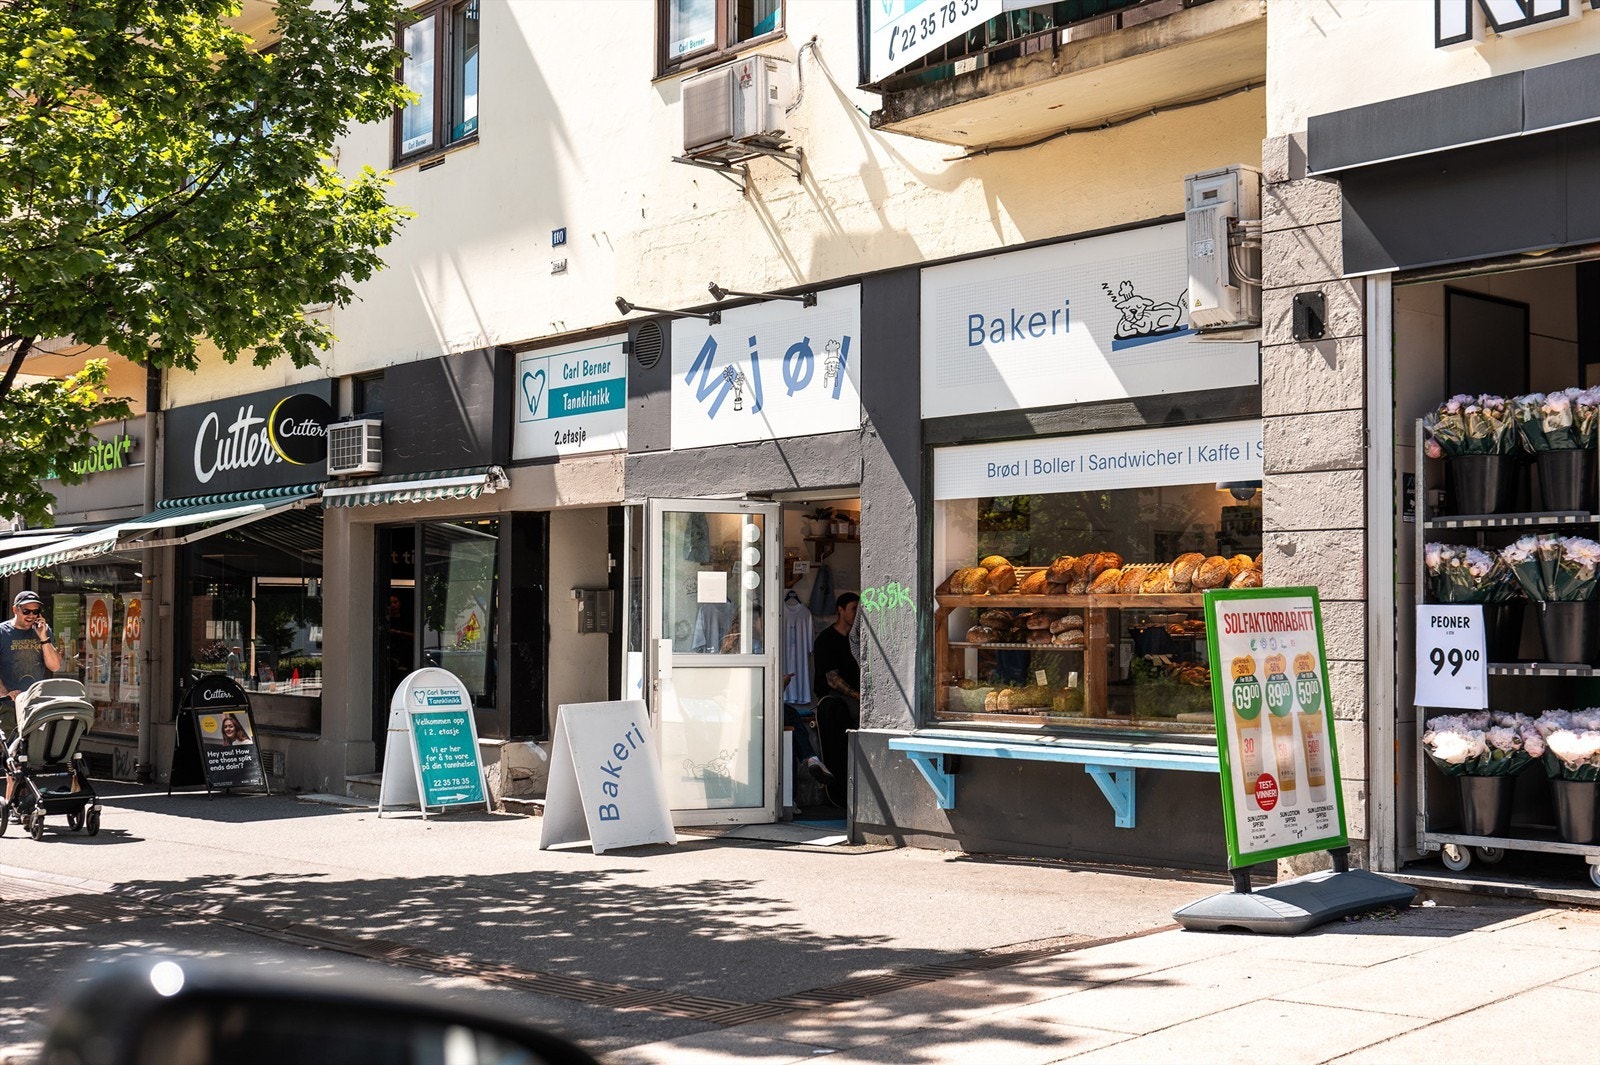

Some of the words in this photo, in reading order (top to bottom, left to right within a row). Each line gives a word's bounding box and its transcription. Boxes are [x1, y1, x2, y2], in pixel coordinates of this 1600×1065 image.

[901, 25, 916, 52] 22
[920, 12, 936, 39] 35
[940, 2, 956, 28] 78
[678, 44, 688, 52] Carl
[690, 38, 705, 49] Berner
[968, 300, 1070, 347] Bakeri
[563, 361, 579, 380] Carl
[582, 360, 611, 377] Berner
[563, 387, 610, 411] Tannklinikk
[194, 404, 284, 484] Cutter
[987, 461, 1020, 478] Brød
[1034, 458, 1076, 474] Boller
[1089, 449, 1183, 471] Sandwicher
[1198, 444, 1240, 462] Kaffe
[127, 616, 141, 638] 50
[1224, 611, 1314, 634] SOLFAKTORRABATT
[1431, 616, 1470, 628] PEONER
[438, 728, 460, 736] etasje
[221, 749, 234, 757] you!
[239, 754, 252, 763] split
[422, 762, 430, 772] på
[599, 722, 645, 821] Bakeri
